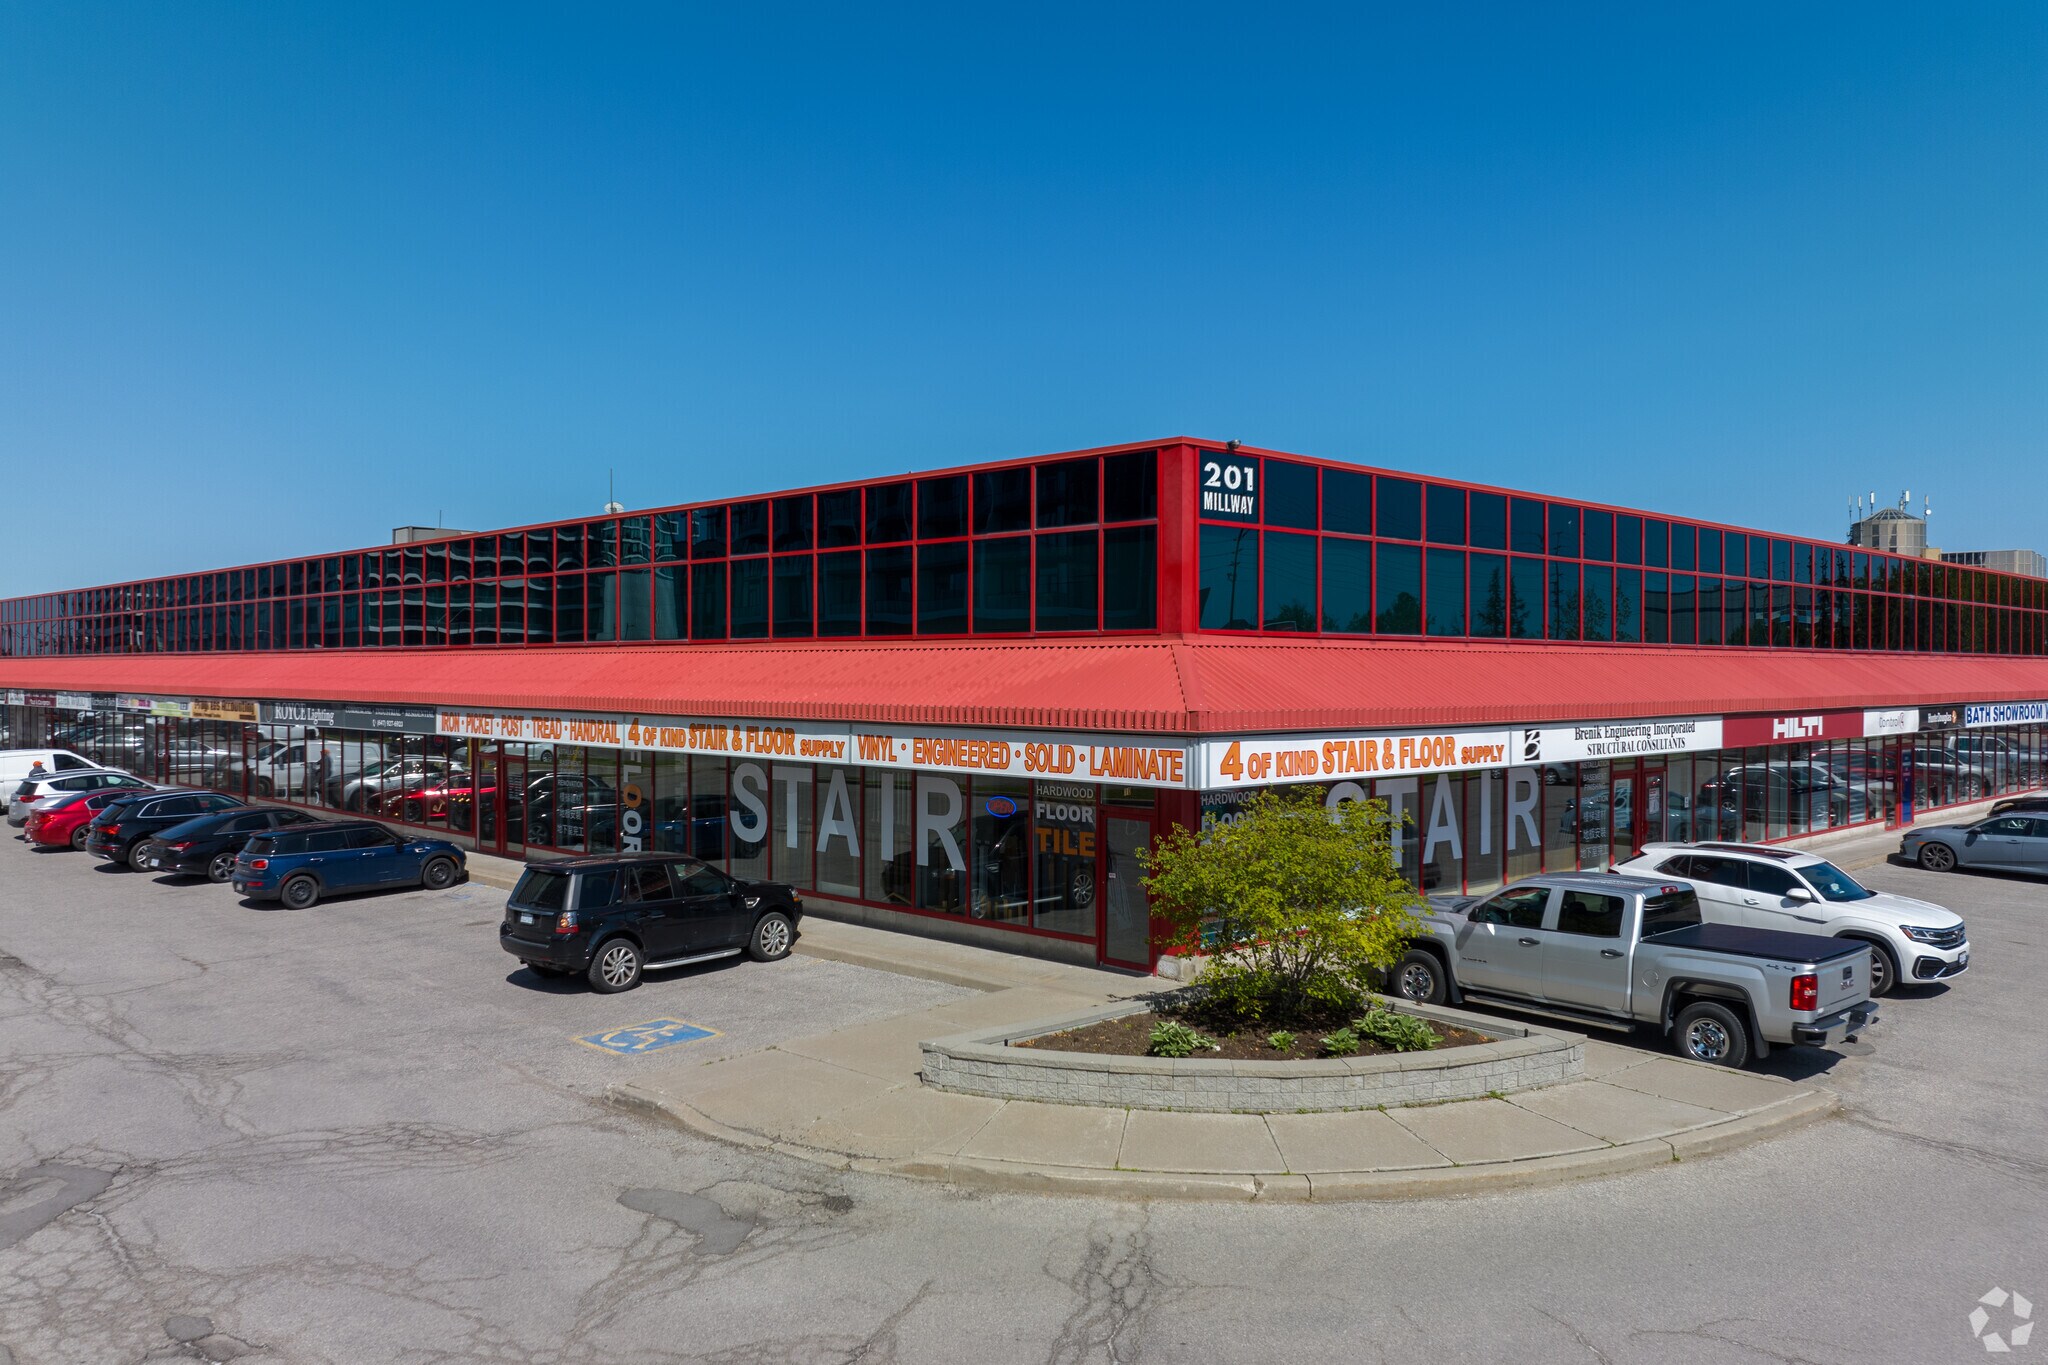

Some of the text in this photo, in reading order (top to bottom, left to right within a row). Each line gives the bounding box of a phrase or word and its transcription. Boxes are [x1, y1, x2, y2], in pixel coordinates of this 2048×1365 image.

[1204, 462, 1253, 491] 201
[1204, 491, 1254, 514] MILLWAY
[274, 703, 335, 725] ROYCE Lighting
[1966, 706, 1991, 724] BATH
[1993, 703, 2042, 722] SHOWROOM
[441, 712, 620, 744] IRON PICKET POST TREAD HANDRAIL
[628, 717, 845, 758] 4 OF KIND STAIR & FLOOR SUPPLY
[1574, 720, 1696, 741] Brenik Engineering Incorporated
[1773, 716, 1823, 739] HILTI
[1587, 737, 1686, 755] STRUCTURAL CONSULTANTS
[857, 734, 1183, 782] VINYL ENGINEERED SOLID LAMINATE
[1220, 736, 1504, 781] 4 OF KIND STAIR & FLOOR SUPPLY
[1036, 785, 1094, 798] HARDWOOD
[730, 762, 966, 871] STAIR
[1036, 803, 1094, 822] FLOOR
[1035, 826, 1096, 857] TILE
